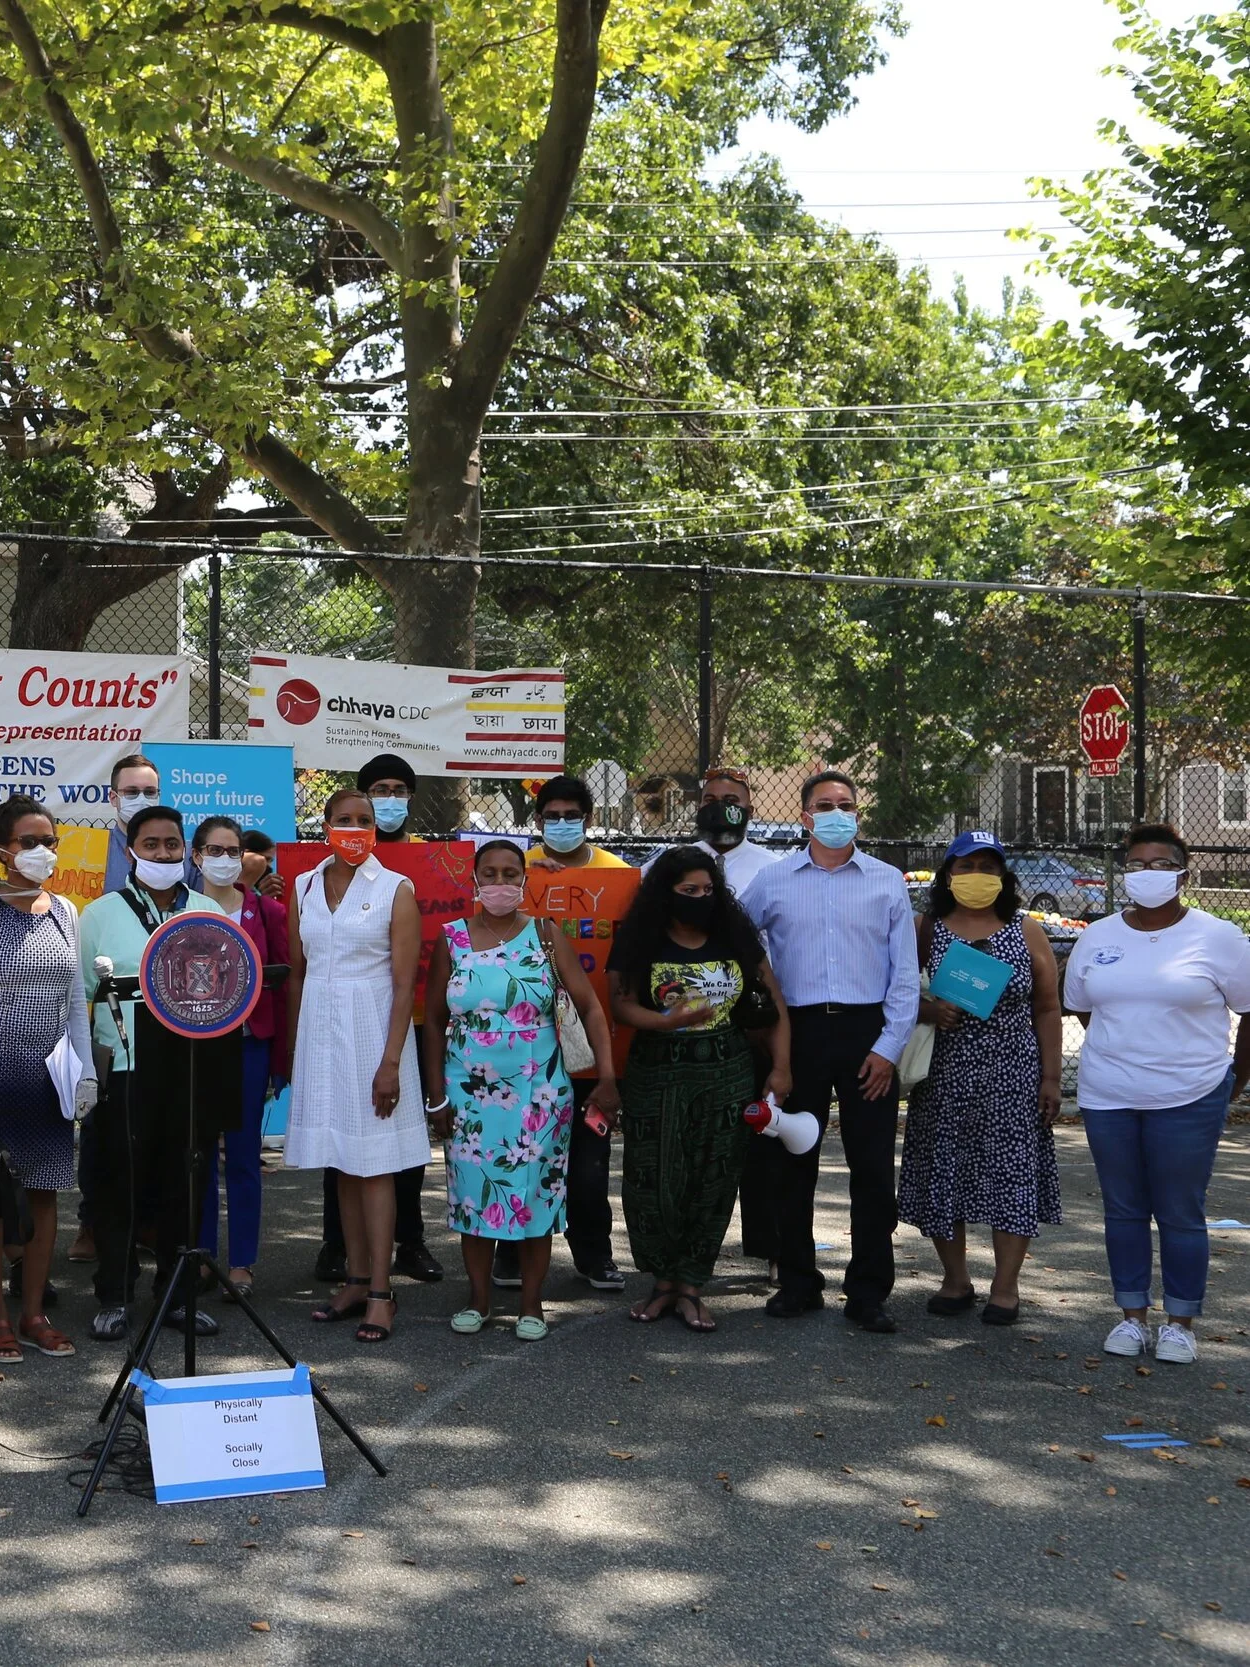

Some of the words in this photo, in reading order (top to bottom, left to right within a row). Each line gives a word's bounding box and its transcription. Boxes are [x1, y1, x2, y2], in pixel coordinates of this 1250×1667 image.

[18, 665, 179, 709] Counts"
[327, 696, 395, 720] chhaya
[399, 705, 431, 720] CDC
[326, 726, 369, 737] Sustaining
[371, 729, 401, 739] Homes
[1083, 712, 1124, 742] STOP
[326, 737, 384, 749] Strengthening
[386, 740, 441, 751] Communities
[463, 747, 557, 760] www.chhayacdc.org
[171, 769, 228, 788] Shape
[172, 793, 210, 808] your
[215, 791, 264, 806] future
[214, 1398, 263, 1410] Physically
[223, 1413, 258, 1424] Distant
[225, 1442, 263, 1454] Socially
[232, 1457, 260, 1468] Close
